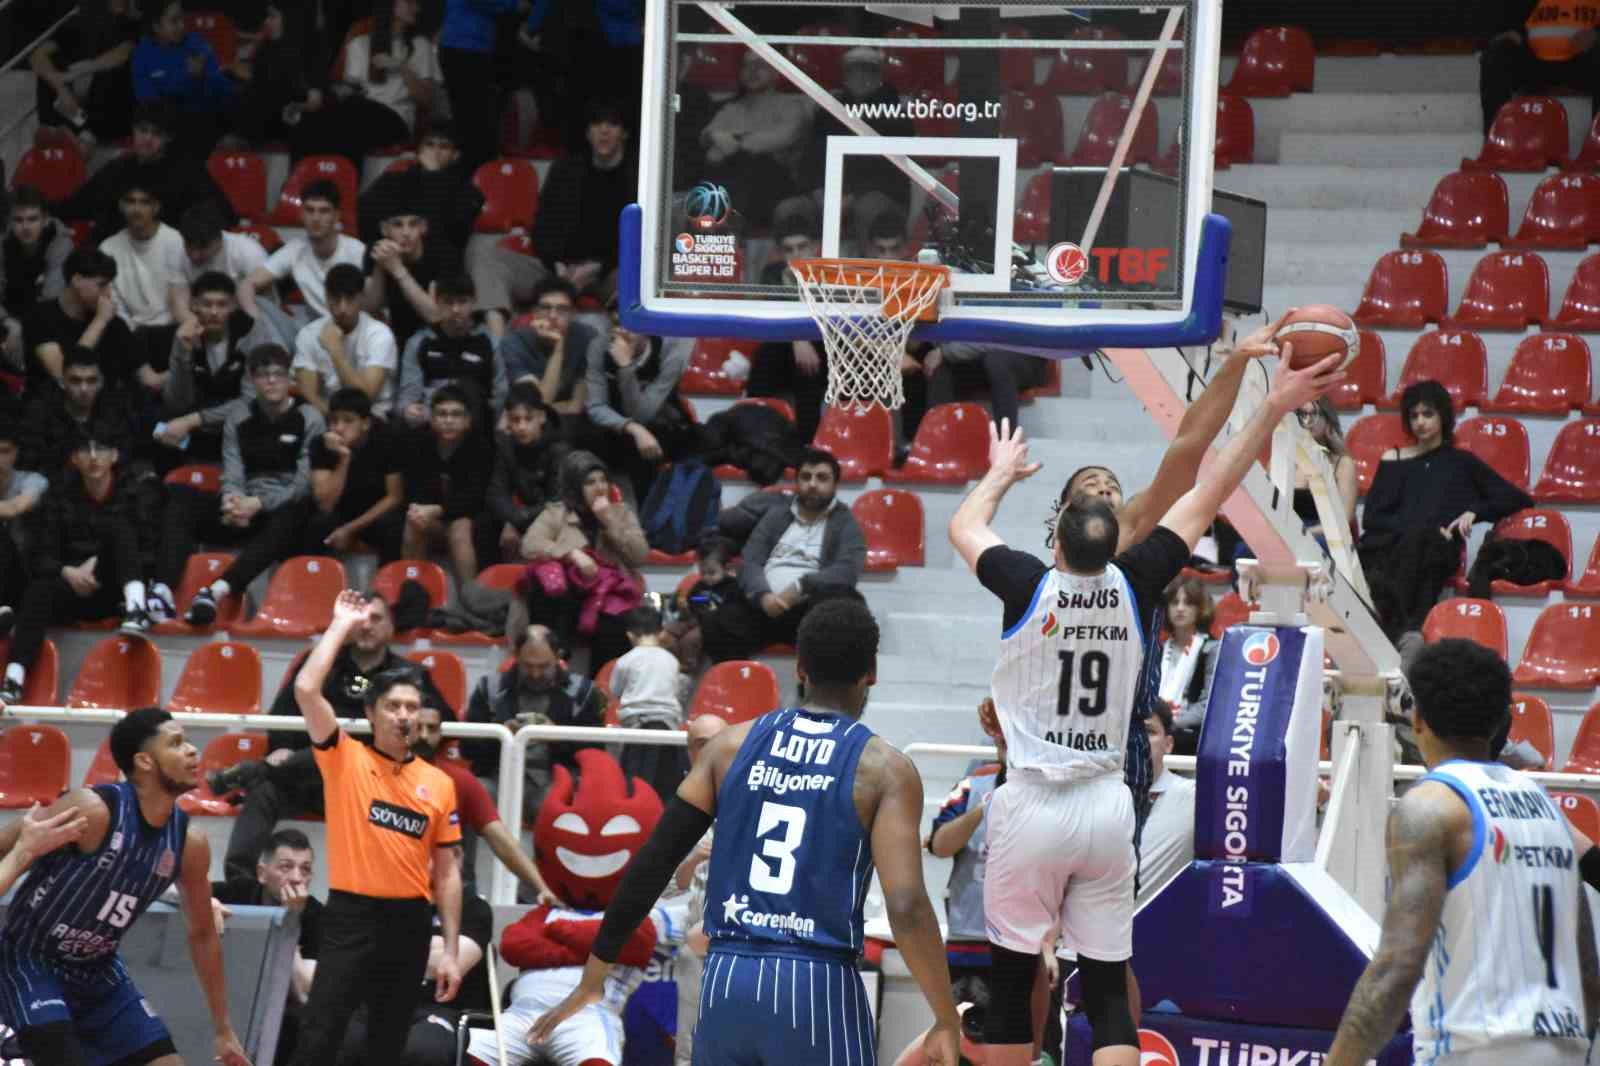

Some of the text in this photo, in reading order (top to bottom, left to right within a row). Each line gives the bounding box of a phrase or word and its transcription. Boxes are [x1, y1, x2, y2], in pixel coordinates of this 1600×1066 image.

[846, 99, 1001, 122] www.tbf.org.tr
[1520, 103, 1543, 114] 15
[1561, 177, 1581, 188] 14
[672, 253, 737, 265] BASKETBOL
[1401, 252, 1423, 265] 15
[1501, 254, 1524, 267] 14
[674, 264, 711, 276] SÜPER
[1092, 247, 1170, 286] TBF
[1440, 334, 1462, 346] 14
[1544, 338, 1568, 351] 13
[1482, 423, 1507, 436] 13
[883, 495, 893, 507] 1
[1523, 515, 1547, 529] 12
[208, 559, 219, 571] 7
[1057, 588, 1119, 609] SAJUS
[1457, 603, 1482, 617] 12
[1568, 605, 1592, 619] 11
[741, 666, 751, 680] 1
[1056, 650, 1110, 717] 19
[30, 731, 43, 746] 7
[770, 730, 837, 766] LOYD
[747, 760, 835, 795] Bilyoner
[748, 800, 808, 895] 3
[96, 889, 139, 929] 15
[741, 910, 815, 934] corendon
